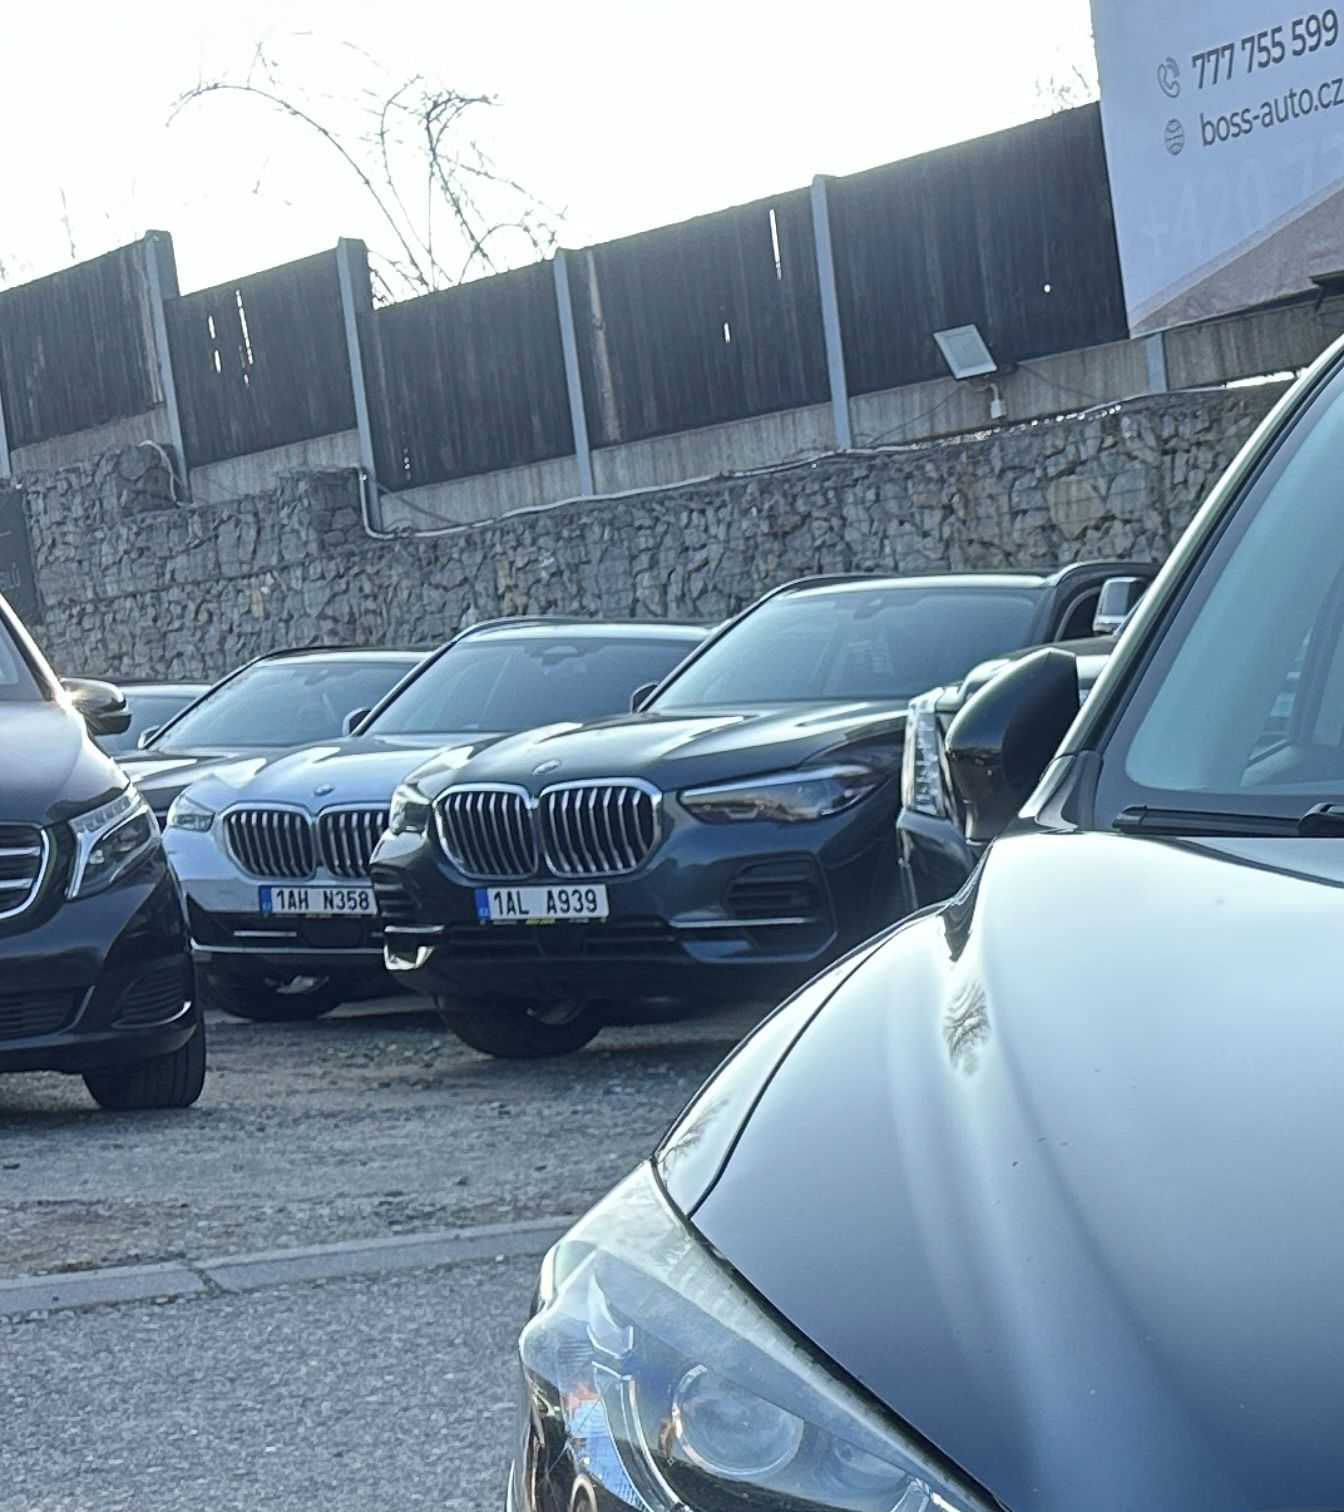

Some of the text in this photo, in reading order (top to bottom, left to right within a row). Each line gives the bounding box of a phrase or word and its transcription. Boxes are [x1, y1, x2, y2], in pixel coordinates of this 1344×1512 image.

[1191, 9, 1339, 89] 777 755 599
[1200, 78, 1344, 147] boss-auto.cz
[276, 889, 309, 910] 1AH
[323, 889, 369, 910] N358
[493, 888, 597, 915] 1AL A939
